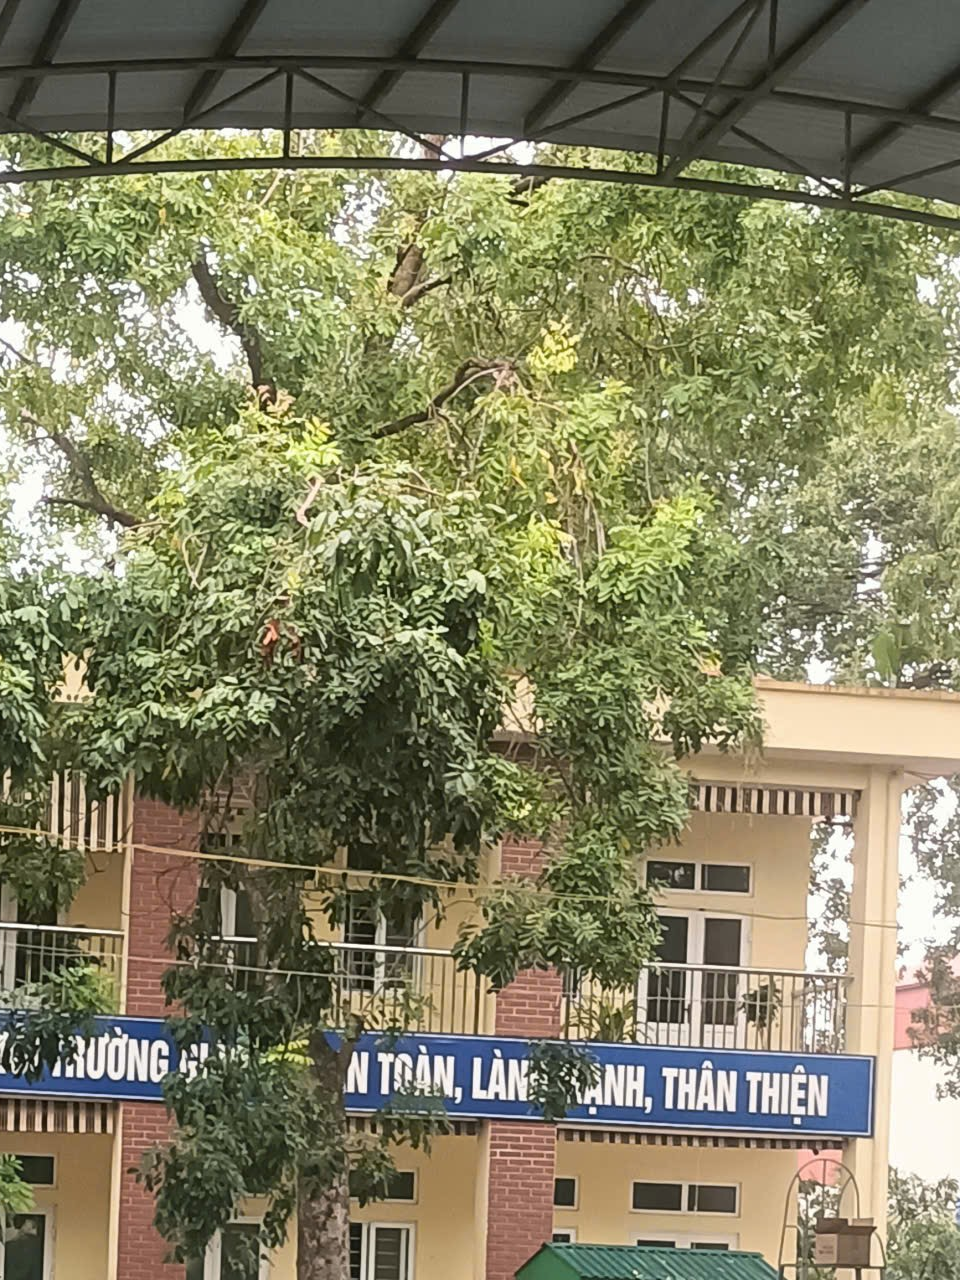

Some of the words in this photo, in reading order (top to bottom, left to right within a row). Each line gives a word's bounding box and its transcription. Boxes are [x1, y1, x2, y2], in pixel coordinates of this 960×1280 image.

[377, 1045, 463, 1104] TOÀN,
[661, 1059, 742, 1113] THÂN
[746, 1066, 829, 1125] THIỆN
